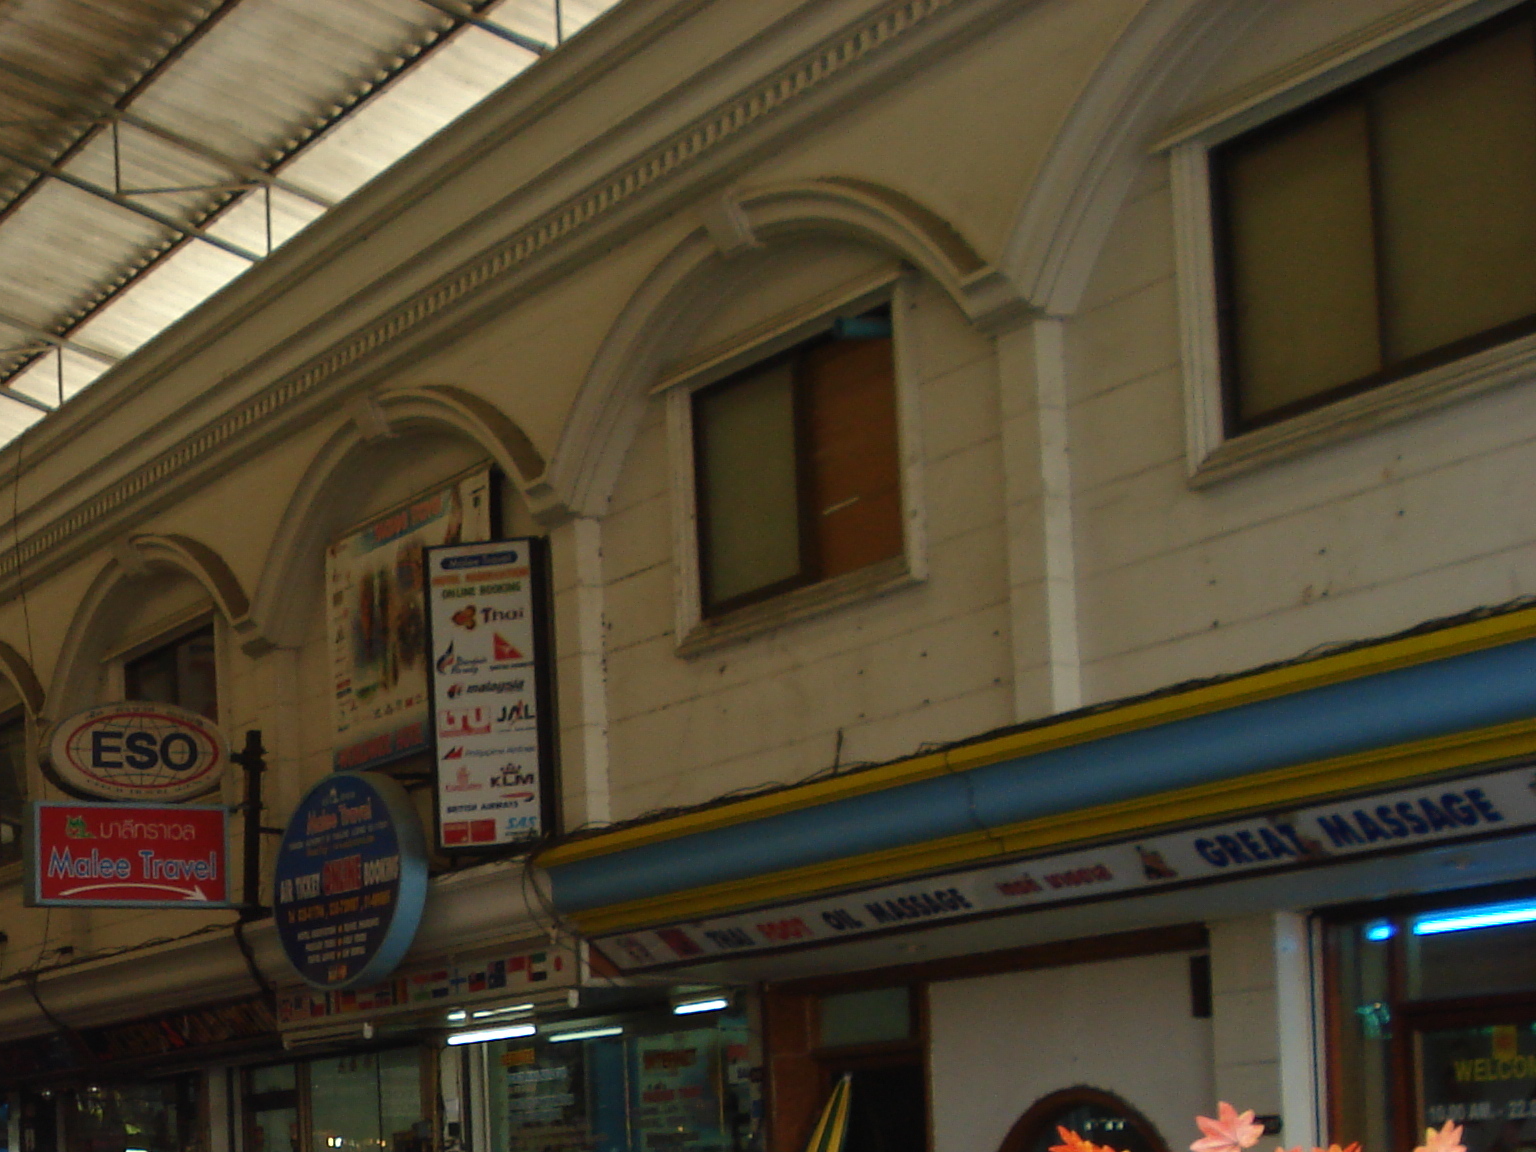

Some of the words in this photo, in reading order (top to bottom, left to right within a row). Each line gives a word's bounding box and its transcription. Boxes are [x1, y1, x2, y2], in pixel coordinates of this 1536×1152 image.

[481, 607, 524, 623] Thai
[91, 731, 197, 771] ESO
[490, 774, 534, 787] KLM
[505, 816, 536, 830] SAS
[1194, 823, 1310, 867] GREAT
[1317, 789, 1504, 848] MASSAGE
[47, 845, 131, 880] Malee
[138, 849, 217, 881] Travel
[822, 909, 864, 930] OIL
[864, 888, 973, 923] MASSAGE
